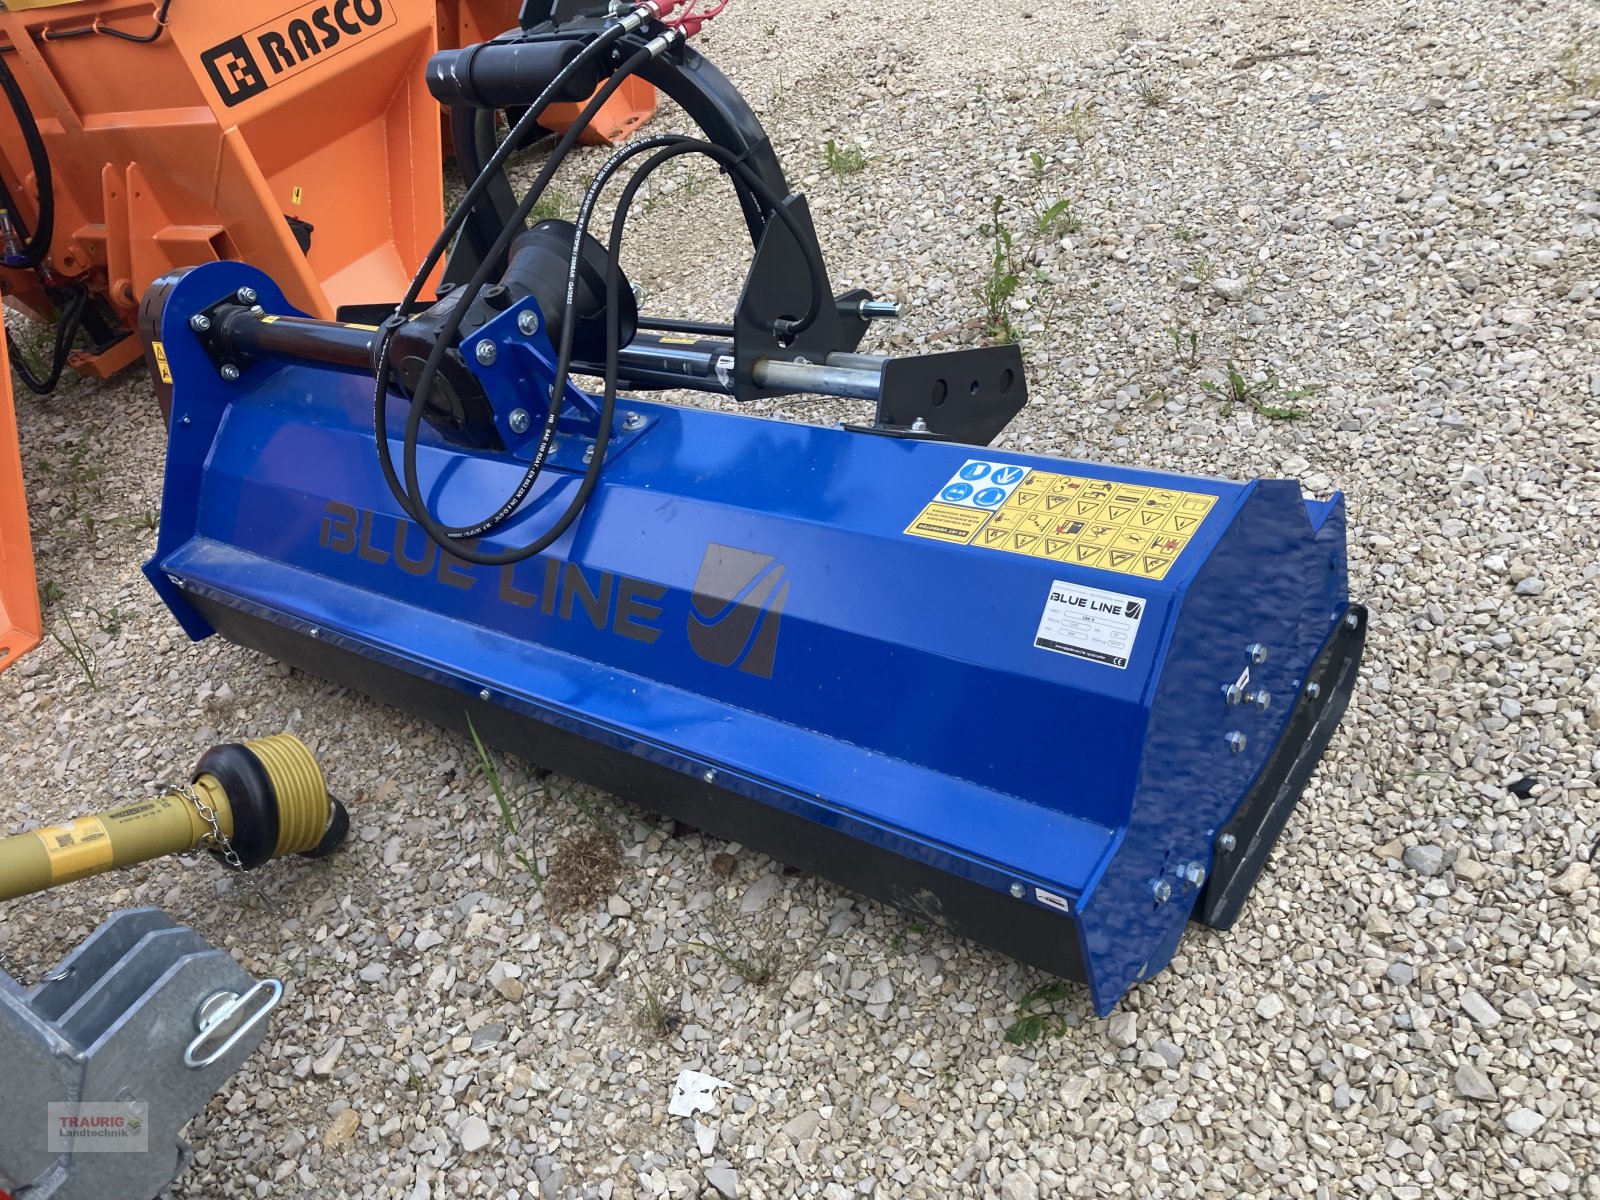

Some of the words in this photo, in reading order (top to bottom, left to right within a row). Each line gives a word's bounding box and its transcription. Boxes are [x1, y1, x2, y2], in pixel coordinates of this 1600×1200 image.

[257, 0, 383, 75] RASCO
[609, 156, 617, 164] EN
[596, 170, 605, 180] 2SN
[533, 452, 543, 467] R2AT
[527, 470, 535, 479] EN
[498, 550, 670, 644] LINE
[1050, 592, 1088, 607] BLUE
[1091, 601, 1122, 615] LINE
